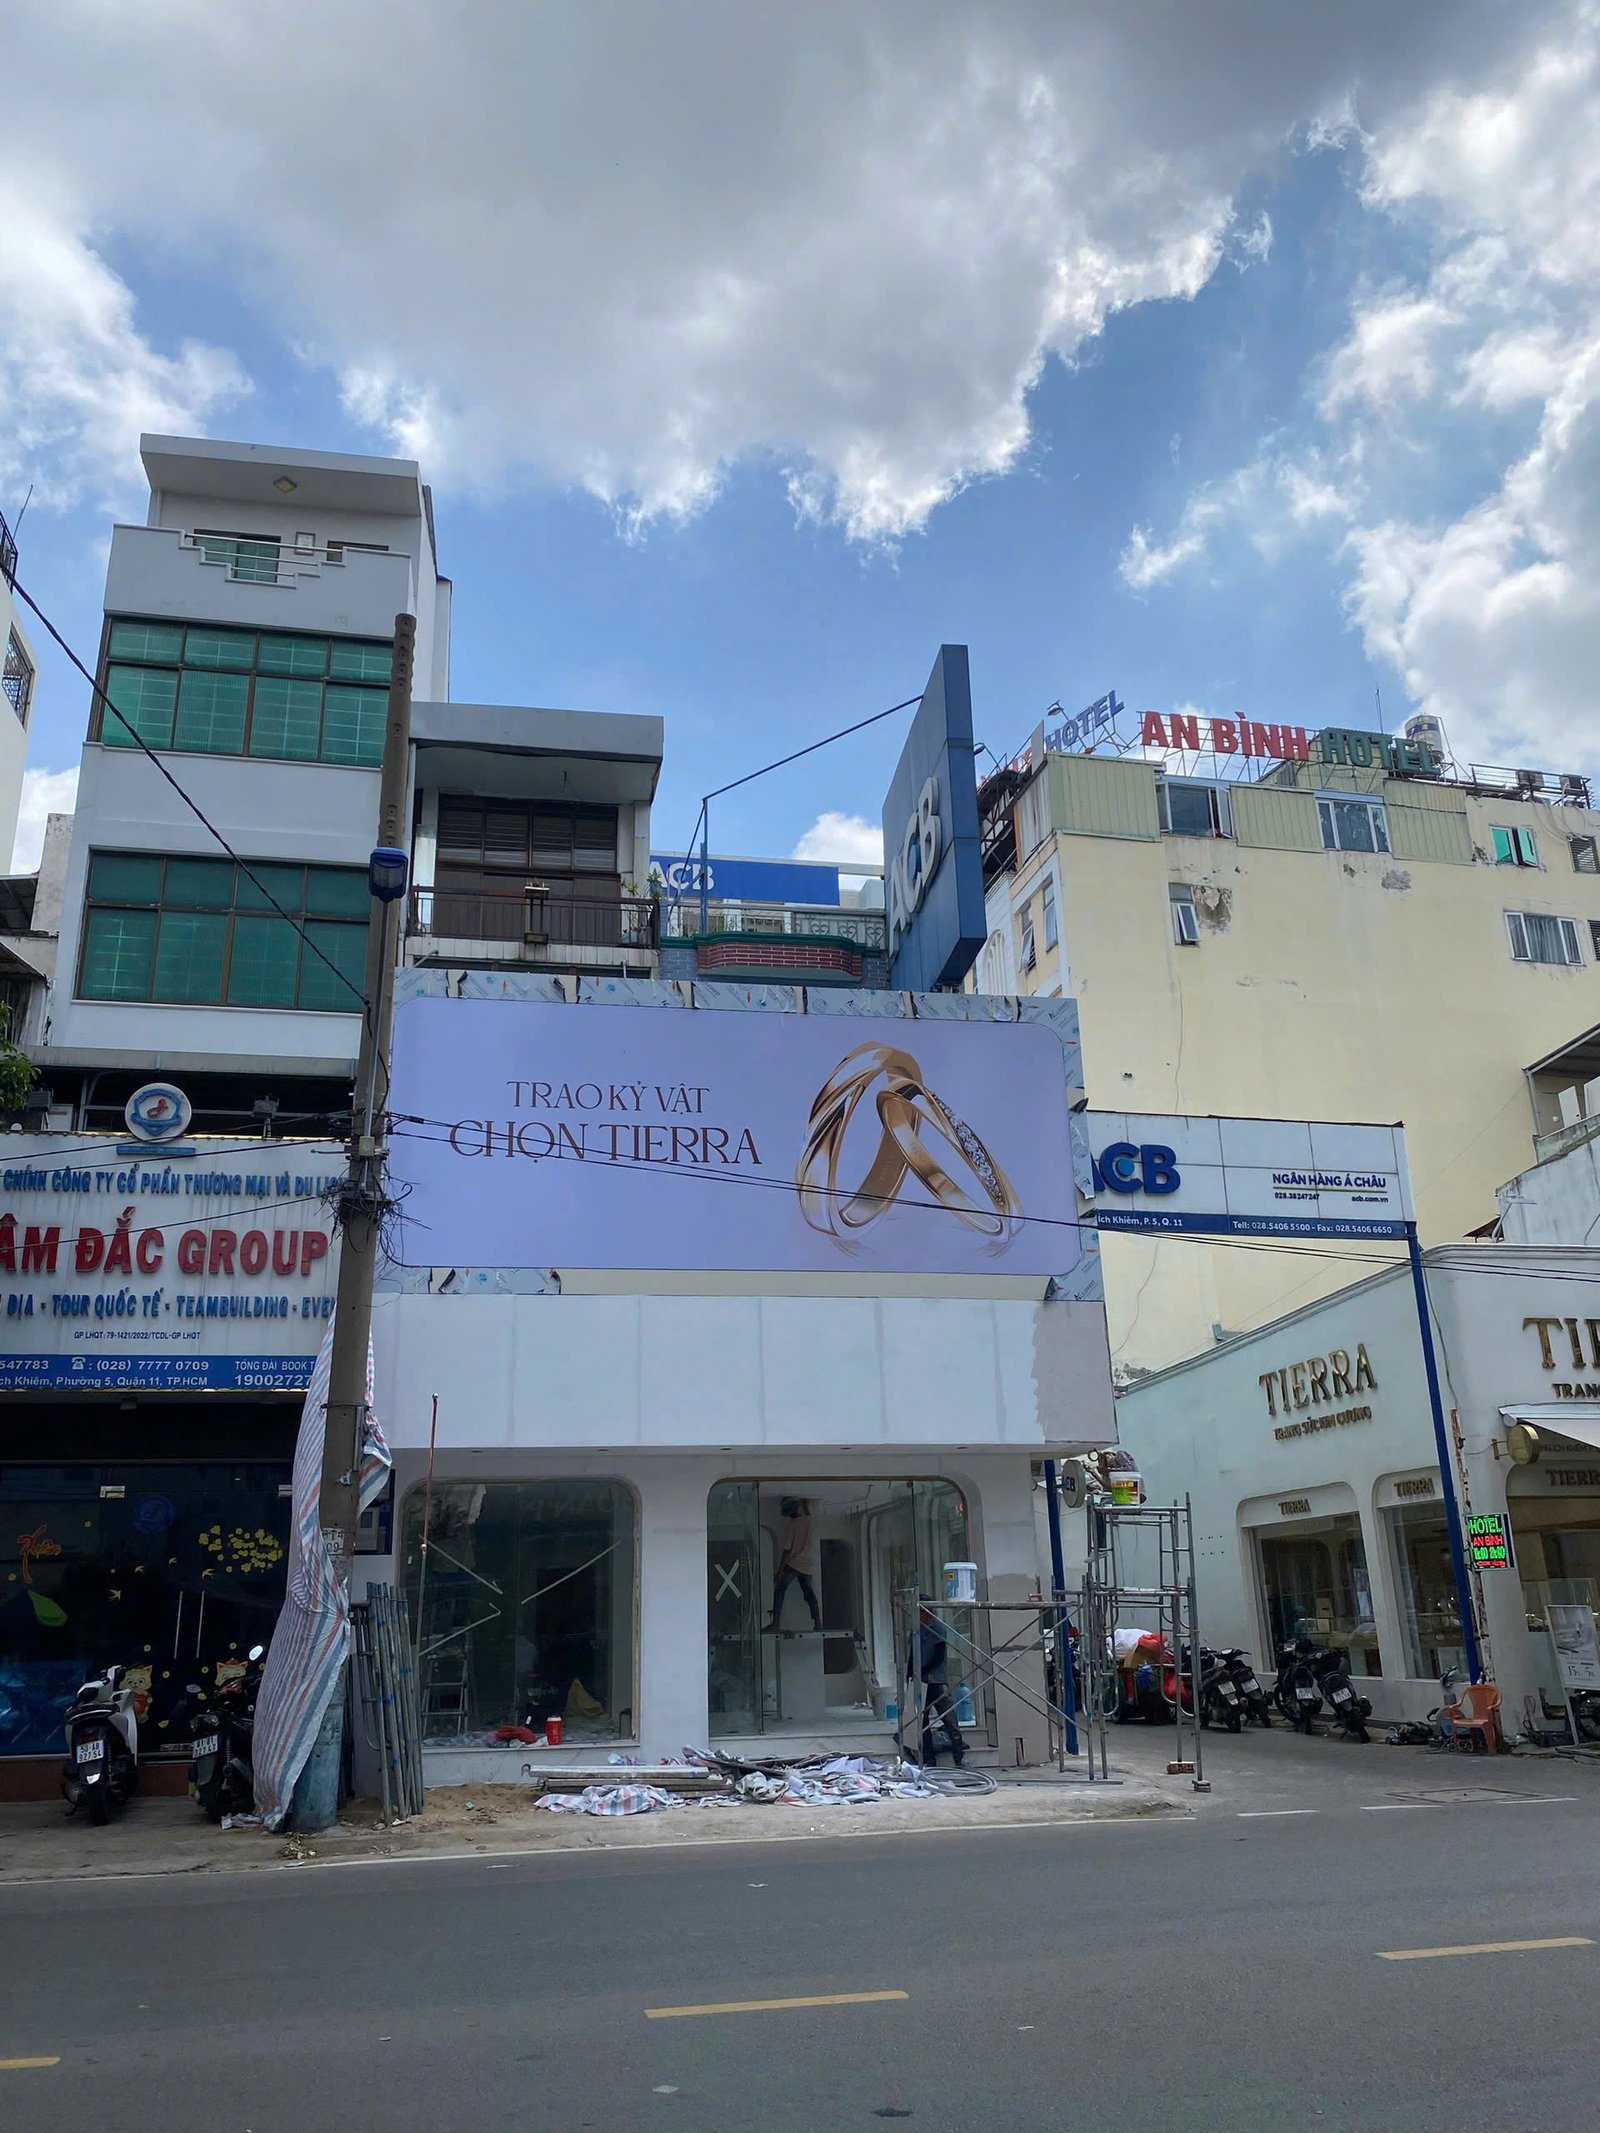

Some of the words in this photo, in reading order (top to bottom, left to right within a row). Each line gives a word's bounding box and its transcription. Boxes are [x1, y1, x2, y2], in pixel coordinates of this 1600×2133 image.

[1045, 690, 1125, 752] HOTEL
[1141, 711, 1200, 750] AN
[1212, 711, 1309, 761] BÌNH
[1319, 727, 1440, 775] HOTEL
[649, 860, 715, 891] ACB
[889, 776, 942, 958] ACB
[506, 1081, 603, 1110] TRAO
[608, 1080, 647, 1111] KỶ
[654, 1083, 710, 1115] VẬT
[449, 1119, 588, 1163] CHỌN
[598, 1124, 763, 1164] TIERRA
[52, 1166, 91, 1192] CÔNG
[95, 1171, 113, 1193] TY
[117, 1163, 140, 1194] CỔ
[141, 1166, 180, 1194] PHẦN
[245, 1174, 271, 1199] MẠI
[275, 1171, 291, 1197] VÀ
[295, 1176, 313, 1197] DU
[1272, 1172, 1306, 1185] NGÂN
[1308, 1172, 1342, 1187] HÀNG
[1344, 1173, 1353, 1187] Á
[1354, 1175, 1387, 1188] CHÂU
[75, 1206, 165, 1274] ĐẮC
[177, 1229, 329, 1276] GROUP
[1251, 1222, 1289, 1231] 028.5406
[1290, 1223, 1311, 1231] 5500
[1335, 1225, 1372, 1233] 028.5406
[1372, 1225, 1393, 1234] 6650
[52, 1294, 91, 1317] TOUR
[94, 1287, 137, 1320] QUỐC
[176, 1295, 289, 1318] TEAMBUILDING
[96, 1360, 132, 1371] (028)
[138, 1360, 170, 1370] 7777
[175, 1361, 209, 1371] 0709
[166, 1376, 208, 1386] TP.HCM
[282, 1361, 307, 1371] BOOK
[1258, 1343, 1378, 1416] TIERRA
[1468, 1517, 1503, 1535] HOTEL
